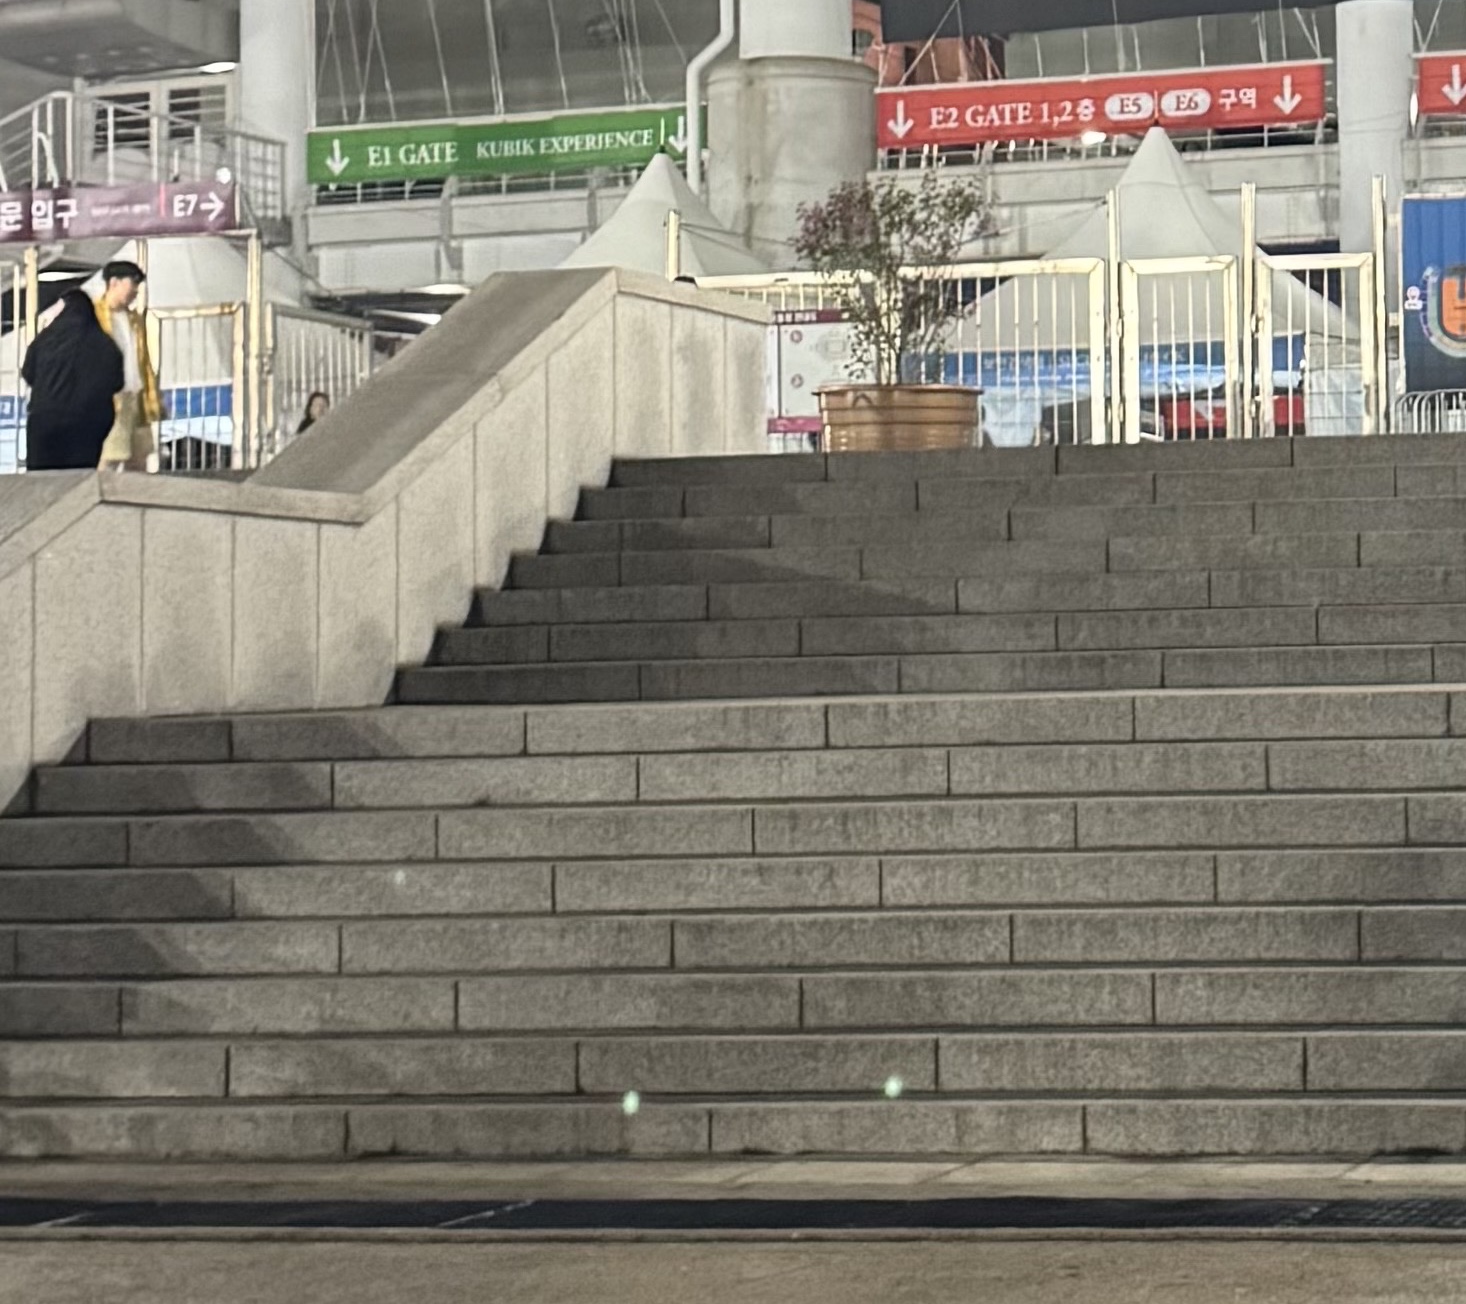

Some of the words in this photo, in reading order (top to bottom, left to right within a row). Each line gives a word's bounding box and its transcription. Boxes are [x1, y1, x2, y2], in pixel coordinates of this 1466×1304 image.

[929, 106, 959, 130] E2
[965, 101, 1033, 127] GATE
[1119, 96, 1142, 114] E5
[1175, 92, 1199, 110] E6
[1218, 87, 1257, 112] 구역
[368, 145, 391, 168] E1
[400, 141, 459, 164] GATE
[476, 138, 537, 160] KUBIK
[539, 129, 654, 155] EXPERIENCE
[173, 194, 198, 218] E7
